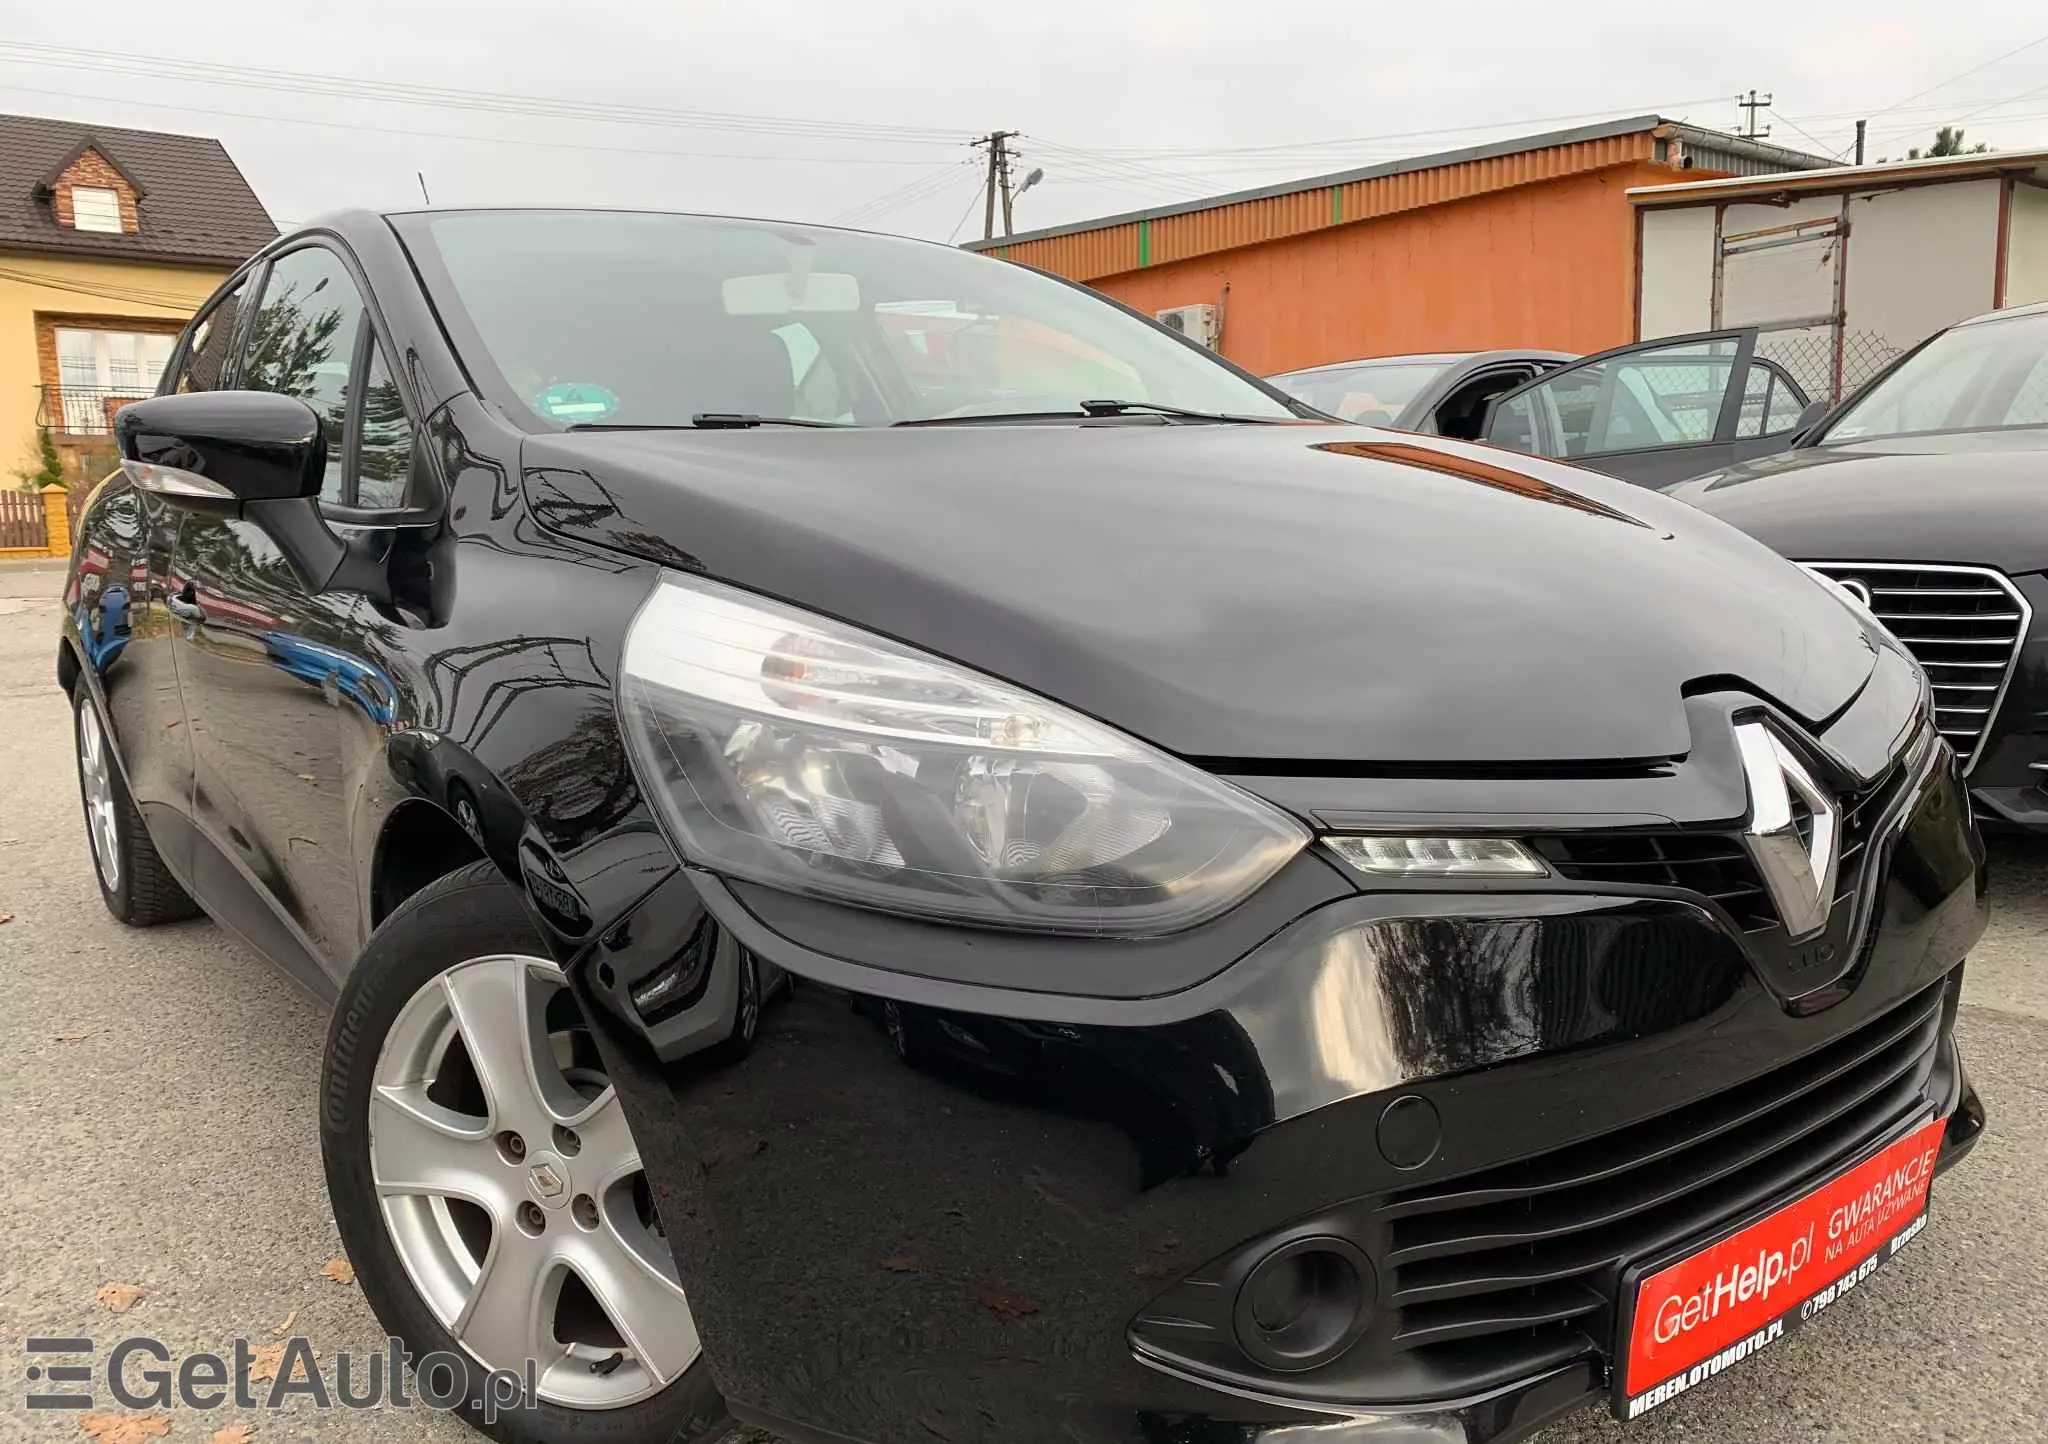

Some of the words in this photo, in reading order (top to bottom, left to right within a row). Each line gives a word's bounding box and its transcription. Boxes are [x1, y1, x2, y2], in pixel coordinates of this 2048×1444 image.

[1824, 1239, 1843, 1264] NA
[1846, 1217, 1876, 1250] AUTA
[1828, 1148, 1935, 1240] GWARANCJE
[1628, 1319, 1785, 1421] MEREN.OTOMOTO.PL
[1812, 1285, 1836, 1314] 798
[1837, 1270, 1858, 1298] 743
[1859, 1253, 1878, 1281] 675
[1653, 1221, 1816, 1345] GetHelp.pl
